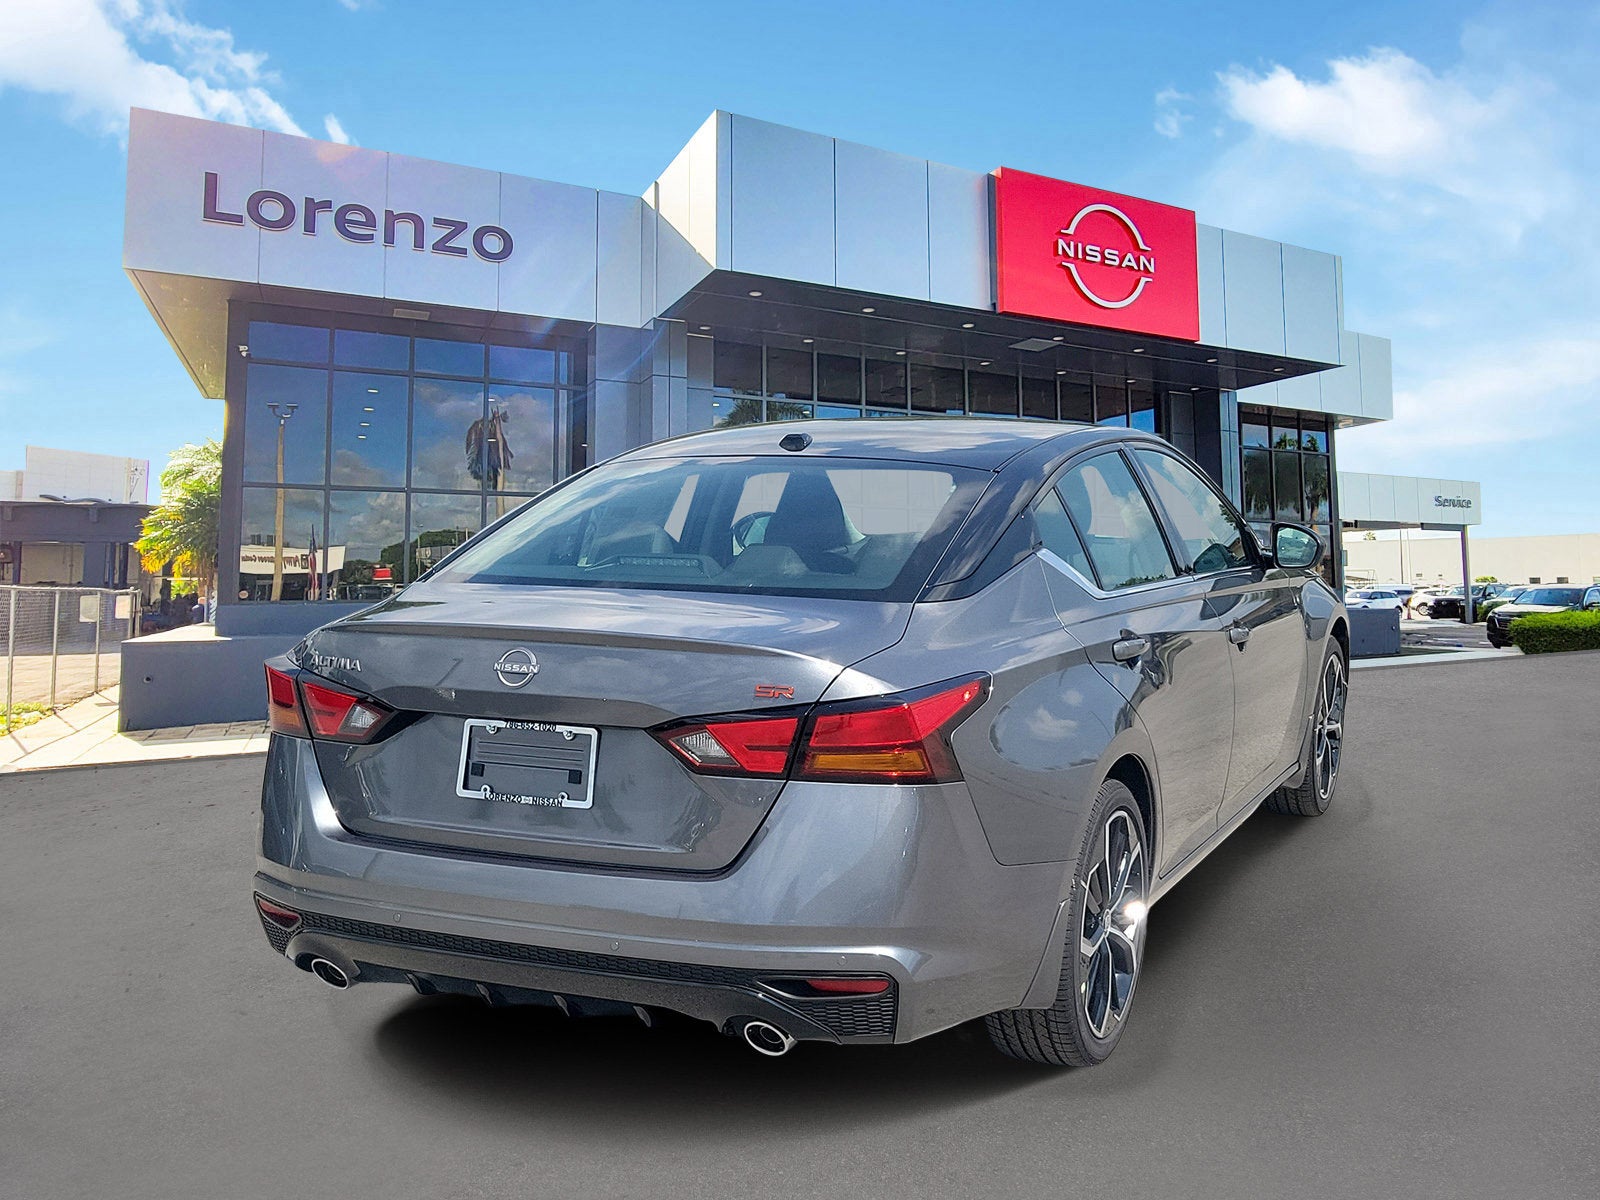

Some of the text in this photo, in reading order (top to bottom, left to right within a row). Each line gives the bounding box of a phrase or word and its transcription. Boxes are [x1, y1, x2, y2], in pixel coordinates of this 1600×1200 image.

[203, 171, 515, 262] Lorenzo
[1057, 238, 1155, 273] NISSAN
[1434, 495, 1472, 509] Service
[310, 654, 362, 672] ALTIMA
[493, 662, 538, 673] NISSAN
[755, 684, 795, 699] SR
[484, 792, 563, 808] LORENZO NISSAN
